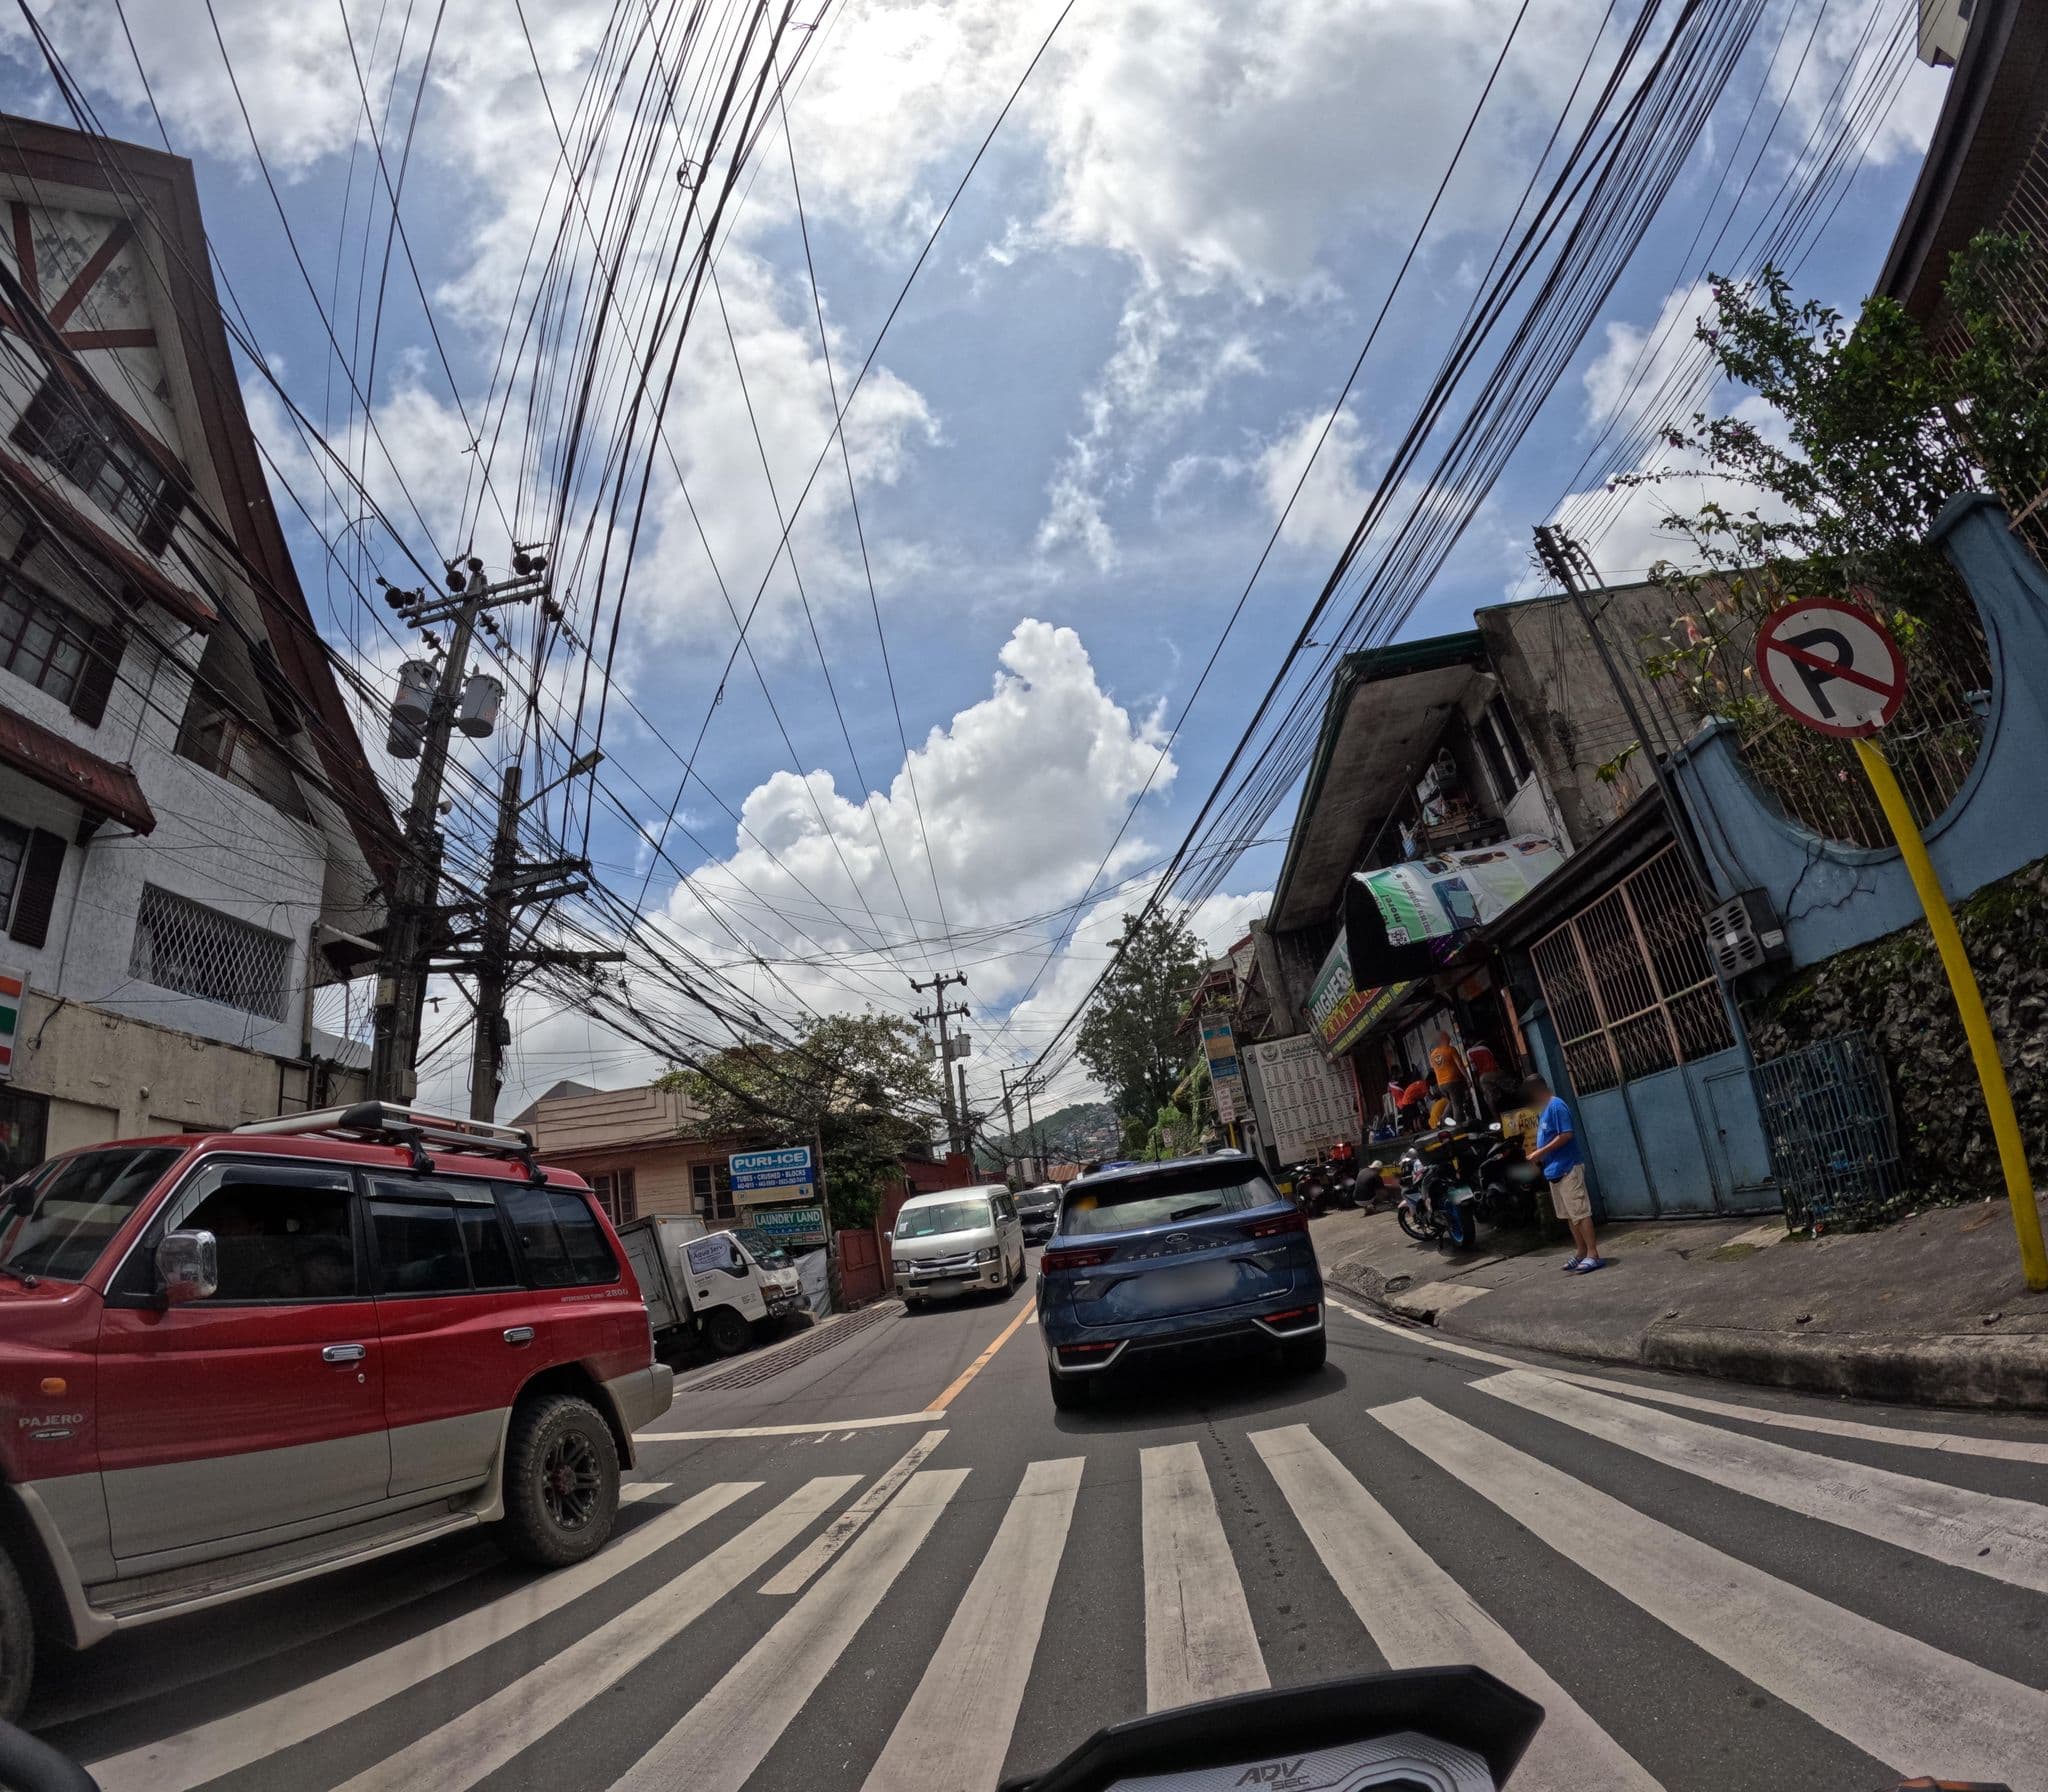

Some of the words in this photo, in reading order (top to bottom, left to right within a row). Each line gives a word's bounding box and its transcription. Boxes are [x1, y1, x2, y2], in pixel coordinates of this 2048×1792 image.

[735, 1152, 805, 1168] PURI-ICE
[757, 1172, 780, 1180] CRUSHED
[785, 1169, 806, 1178] BLOCKS
[756, 1212, 795, 1225] LAUNDRY
[797, 1211, 820, 1222] LAND
[606, 1288, 628, 1297] 2800
[19, 1413, 83, 1428] PAJERO
[1235, 1759, 1305, 1786] ADV
